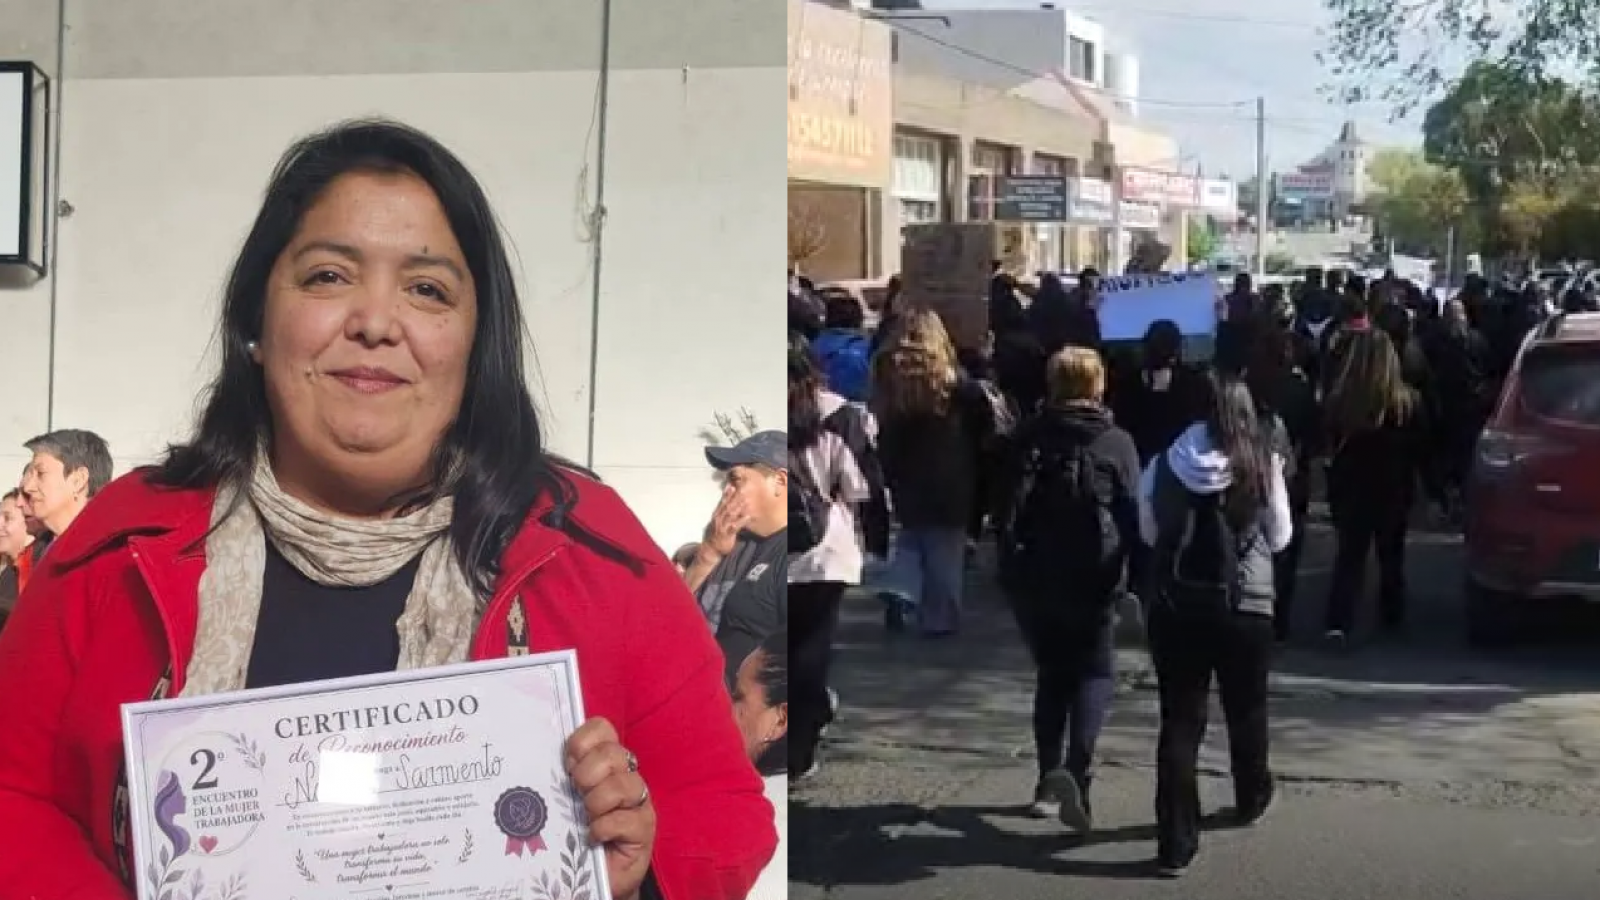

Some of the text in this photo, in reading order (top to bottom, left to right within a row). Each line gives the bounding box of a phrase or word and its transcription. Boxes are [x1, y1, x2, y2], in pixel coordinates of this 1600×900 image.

[274, 694, 479, 739] CERTIFICADO
[288, 742, 310, 765] de
[193, 788, 258, 805] ENCUENTRO
[194, 800, 260, 818] DE LA MUJER
[195, 812, 266, 829] TRABAJADORA
